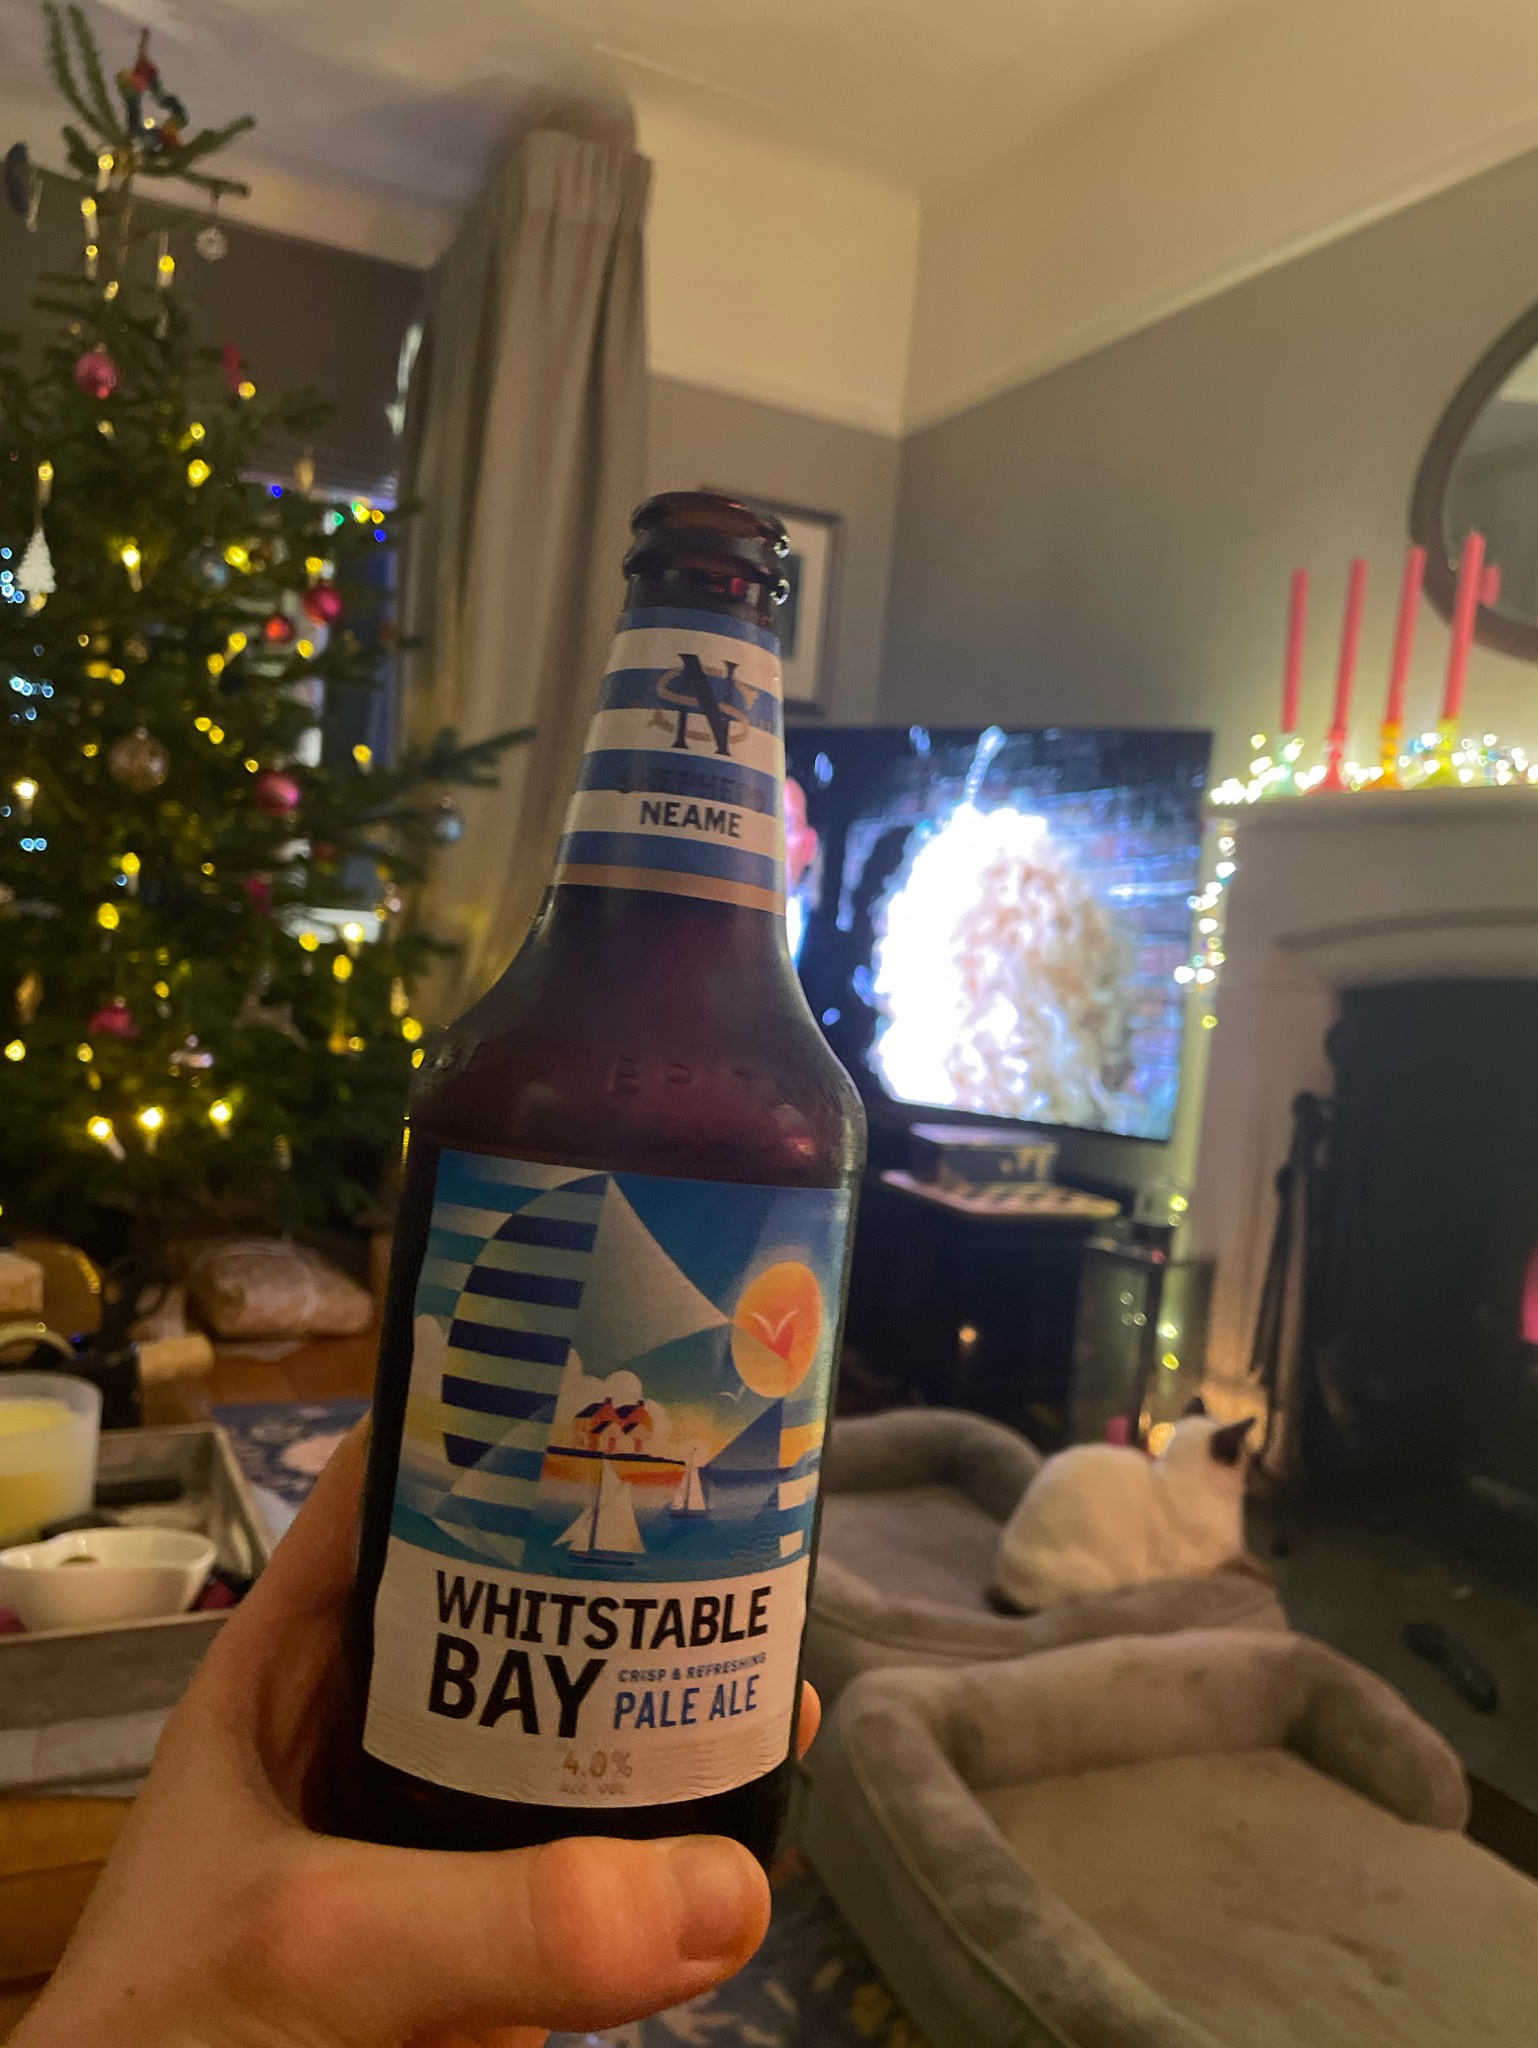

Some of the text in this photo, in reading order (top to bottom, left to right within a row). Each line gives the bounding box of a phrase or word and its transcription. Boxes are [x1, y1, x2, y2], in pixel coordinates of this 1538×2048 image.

[639, 800, 742, 838] NEAME
[435, 1569, 773, 1651] WHITSTABLE
[428, 1633, 608, 1738] BAY
[613, 1674, 760, 1730] PALE ALE
[618, 1668, 666, 1682] CRISP
